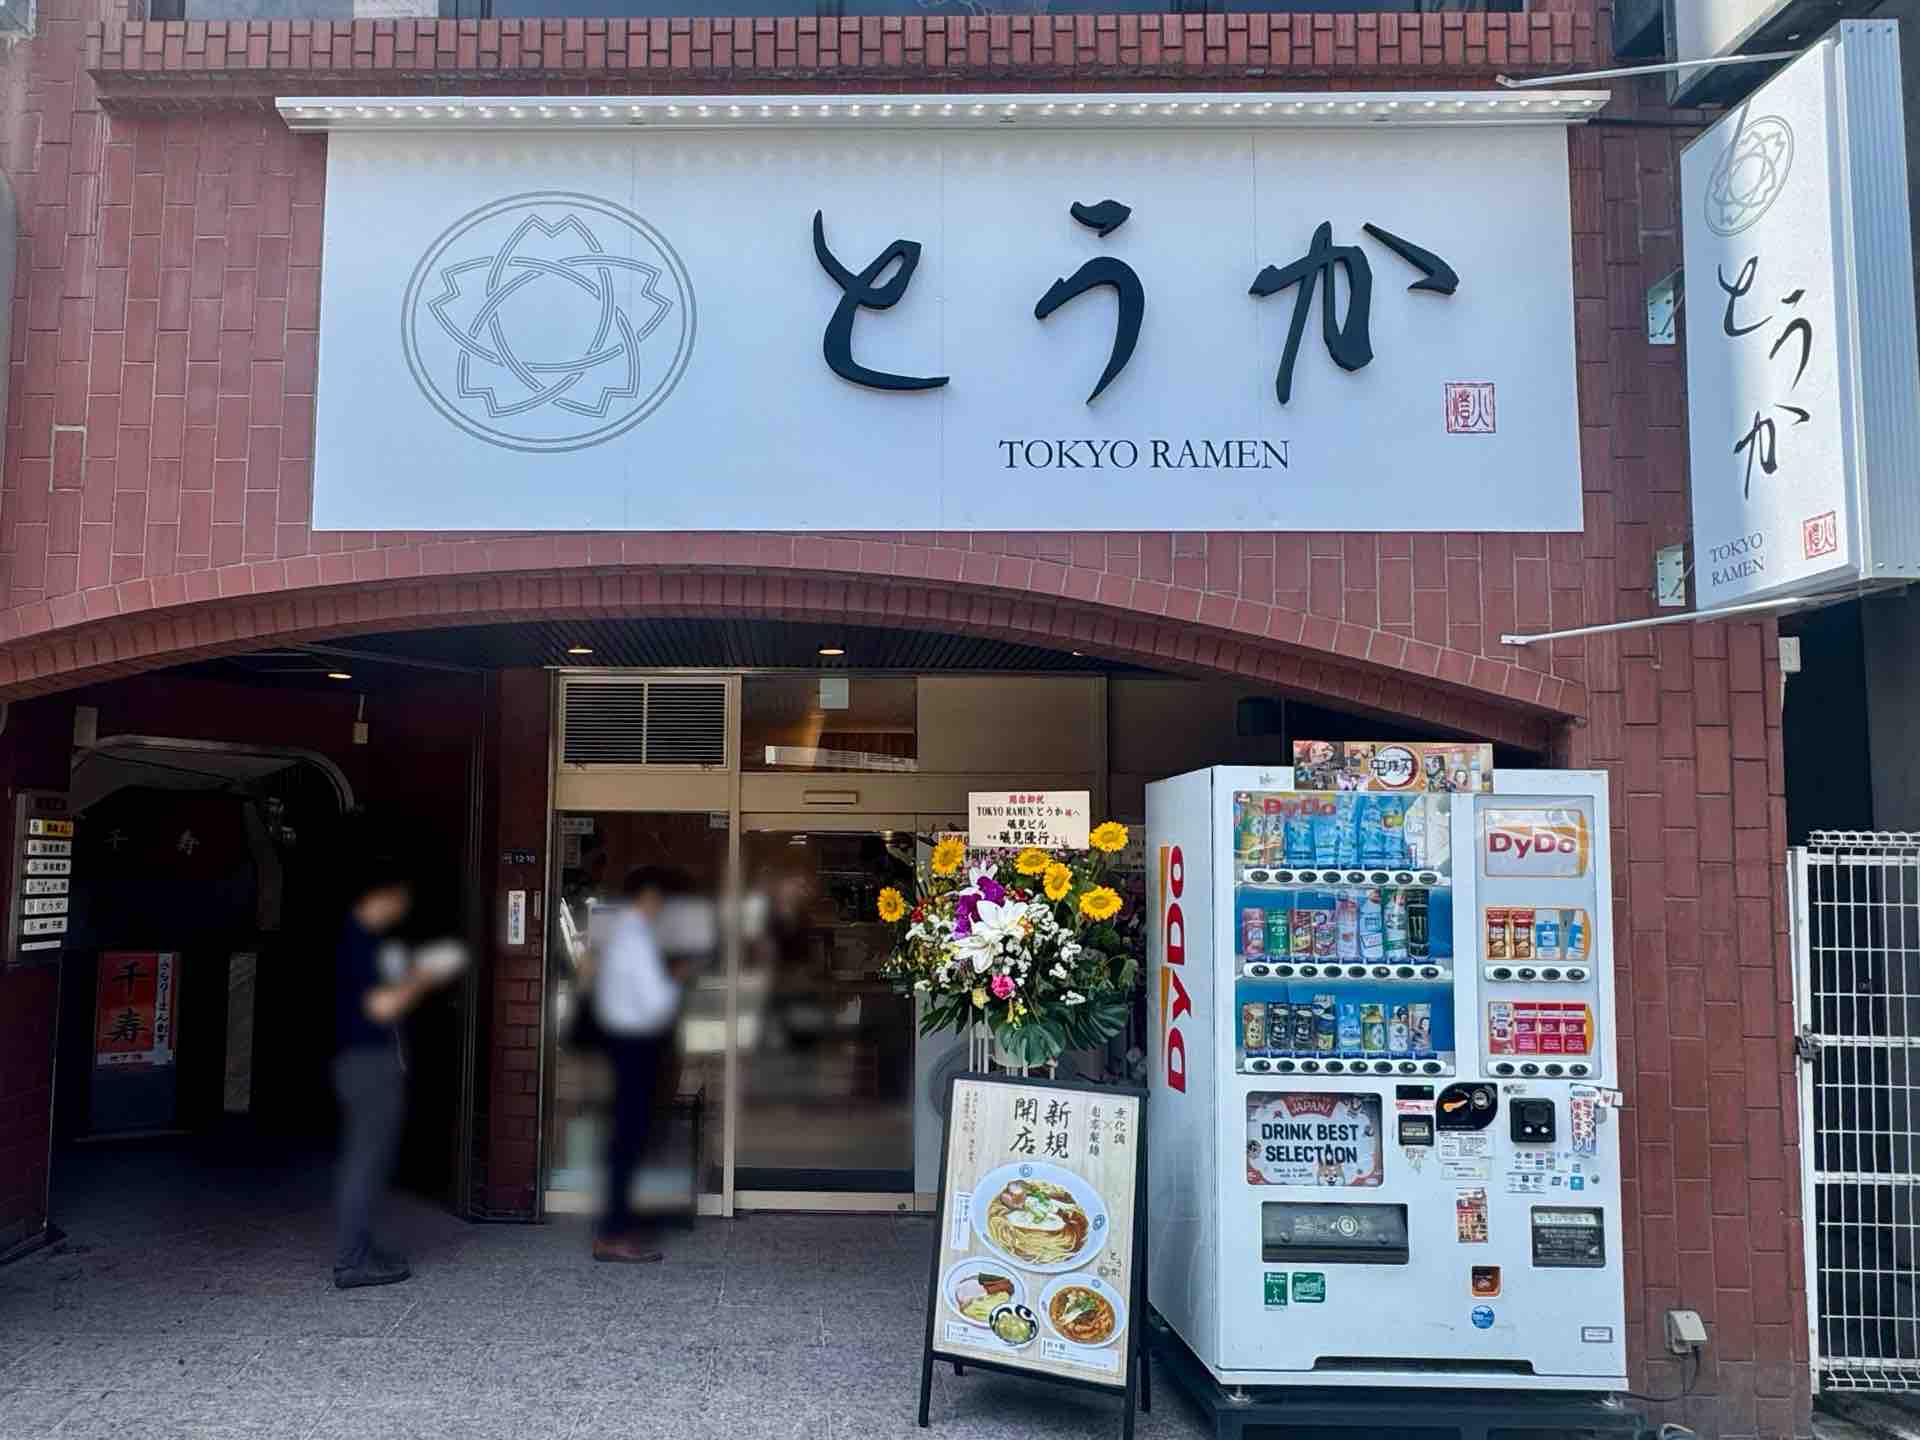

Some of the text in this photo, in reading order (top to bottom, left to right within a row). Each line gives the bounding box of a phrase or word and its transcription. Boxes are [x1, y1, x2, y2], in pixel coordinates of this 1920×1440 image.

[813, 199, 1460, 406] とうか
[1717, 256, 1812, 501] とうか
[999, 439, 1290, 469] TOKYO RAMEN
[1710, 532, 1764, 563] TOKYO
[1711, 556, 1765, 587] RAMEN
[976, 806, 1004, 817] TOKYO
[1489, 832, 1577, 859] DyDo
[1009, 1098, 1039, 1155] 開店
[1042, 1099, 1072, 1159] 新規
[1262, 1123, 1359, 1141] DRINK BEST
